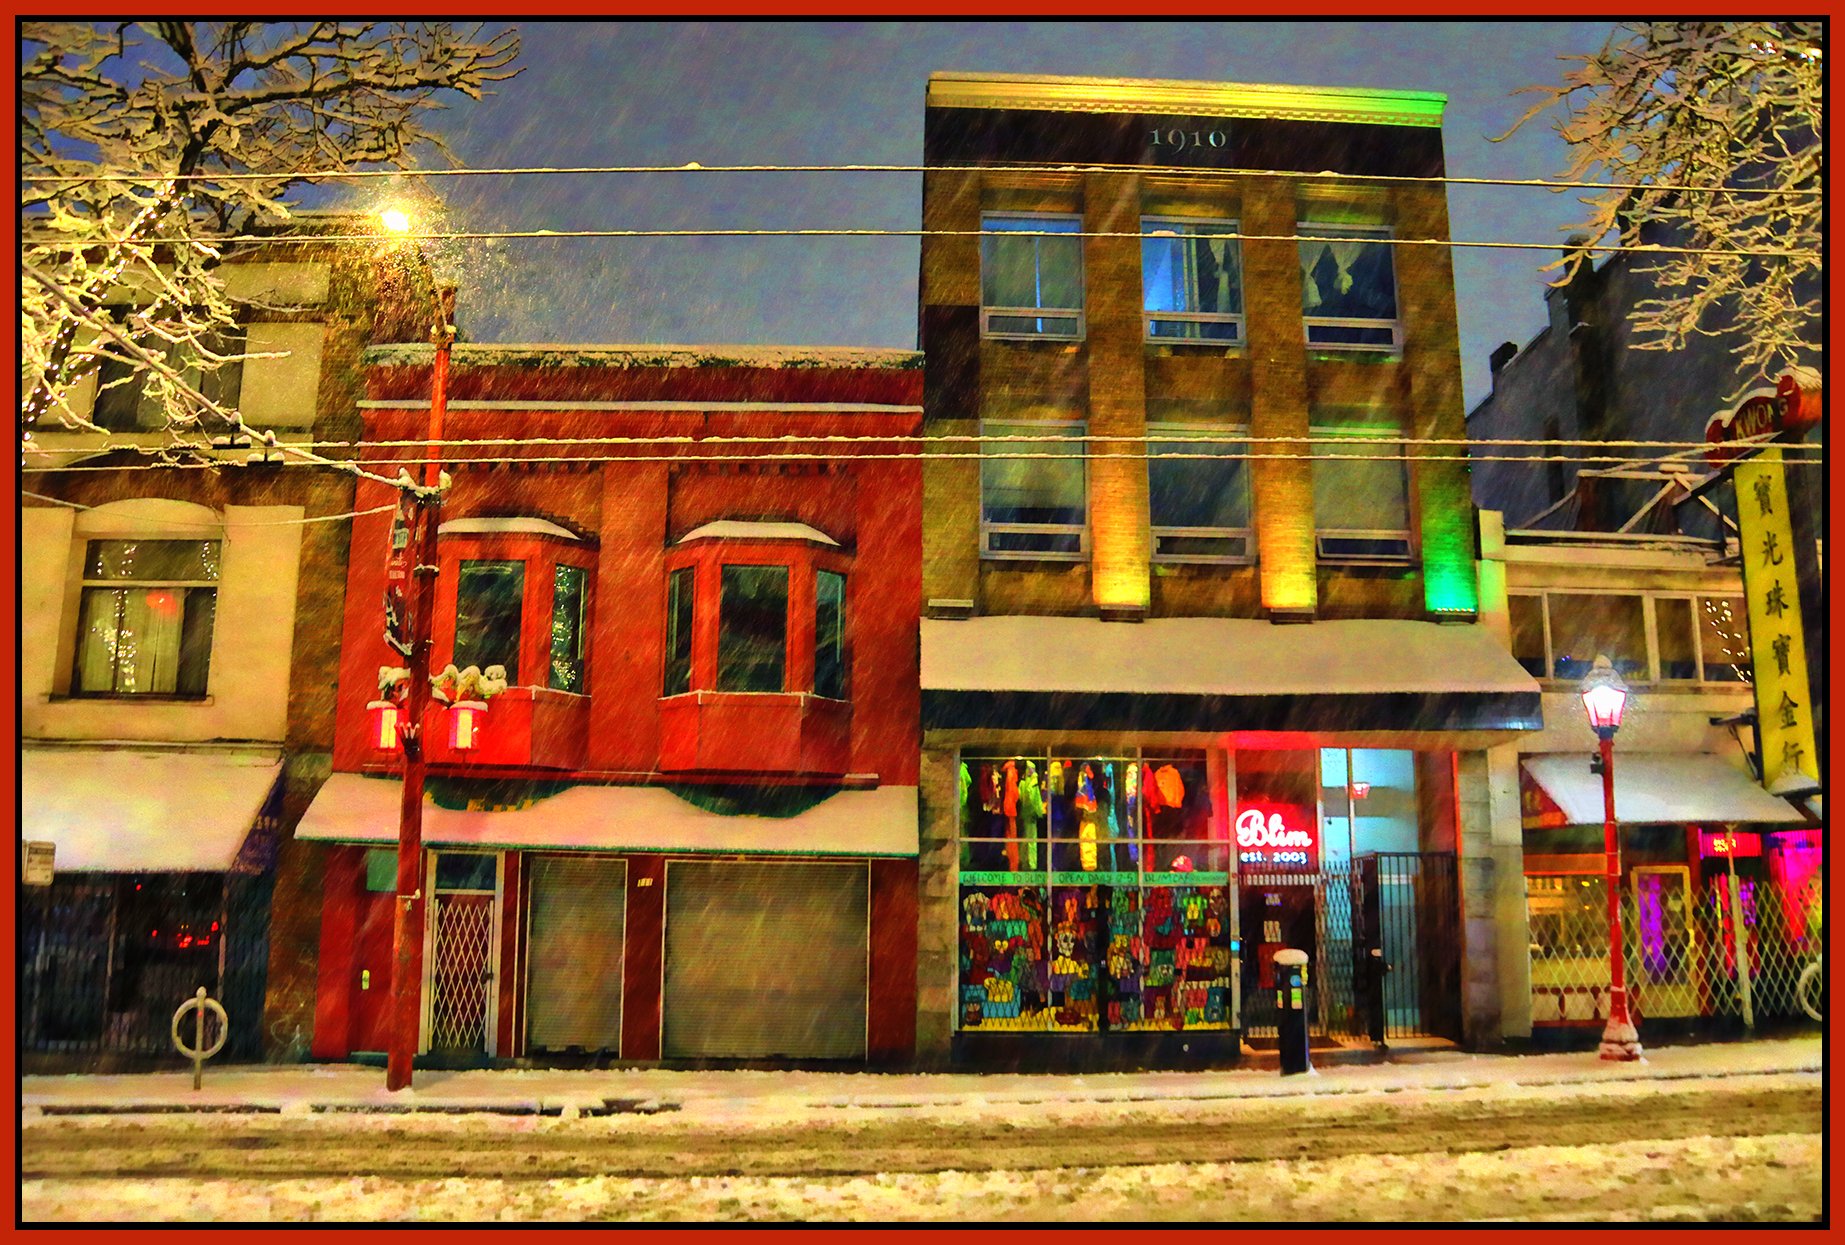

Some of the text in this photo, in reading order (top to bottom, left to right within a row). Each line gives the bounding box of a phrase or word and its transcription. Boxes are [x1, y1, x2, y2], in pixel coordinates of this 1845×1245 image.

[1150, 128, 1226, 154] 1910
[1235, 809, 1313, 848] Blim
[1240, 850, 1308, 865] est. 2003
[963, 872, 1006, 884] WELCOME
[1012, 872, 1022, 883] TO
[1058, 872, 1084, 884] OPEN
